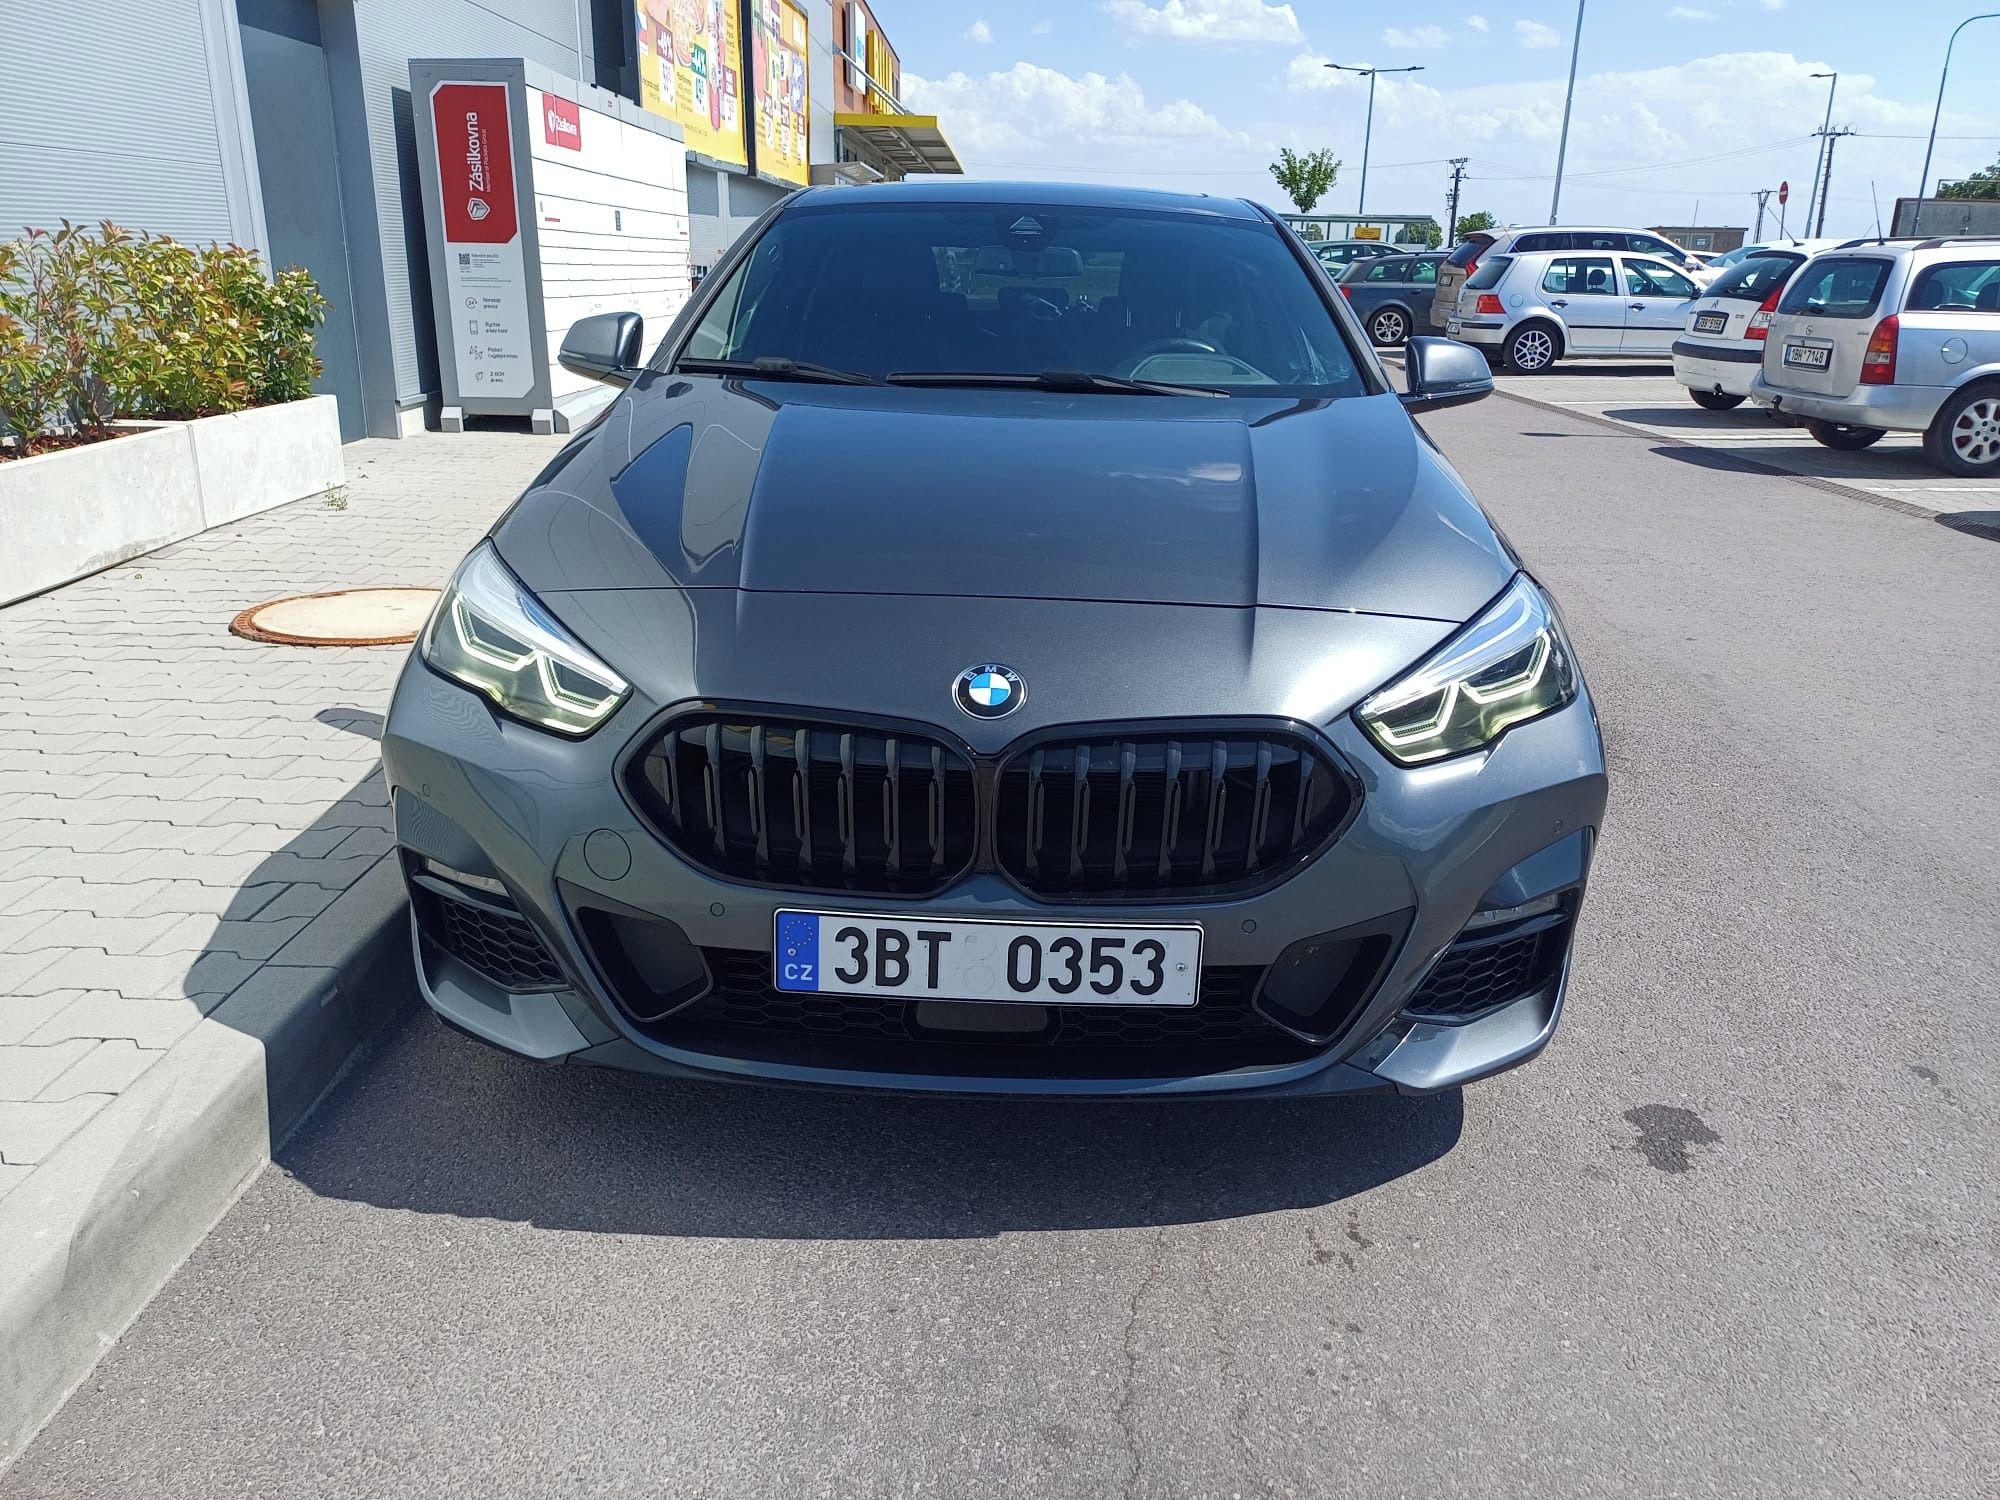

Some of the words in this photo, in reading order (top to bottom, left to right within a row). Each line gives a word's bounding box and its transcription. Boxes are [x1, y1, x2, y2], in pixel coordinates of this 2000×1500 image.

[466, 112, 484, 192] Zásilkovna
[1791, 347, 1804, 362] 1BH
[1805, 350, 1825, 364] 7148
[964, 666, 1019, 682] BMW
[834, 927, 952, 989] 3BT
[1007, 935, 1166, 995] 0353
[784, 963, 813, 981] CZ
